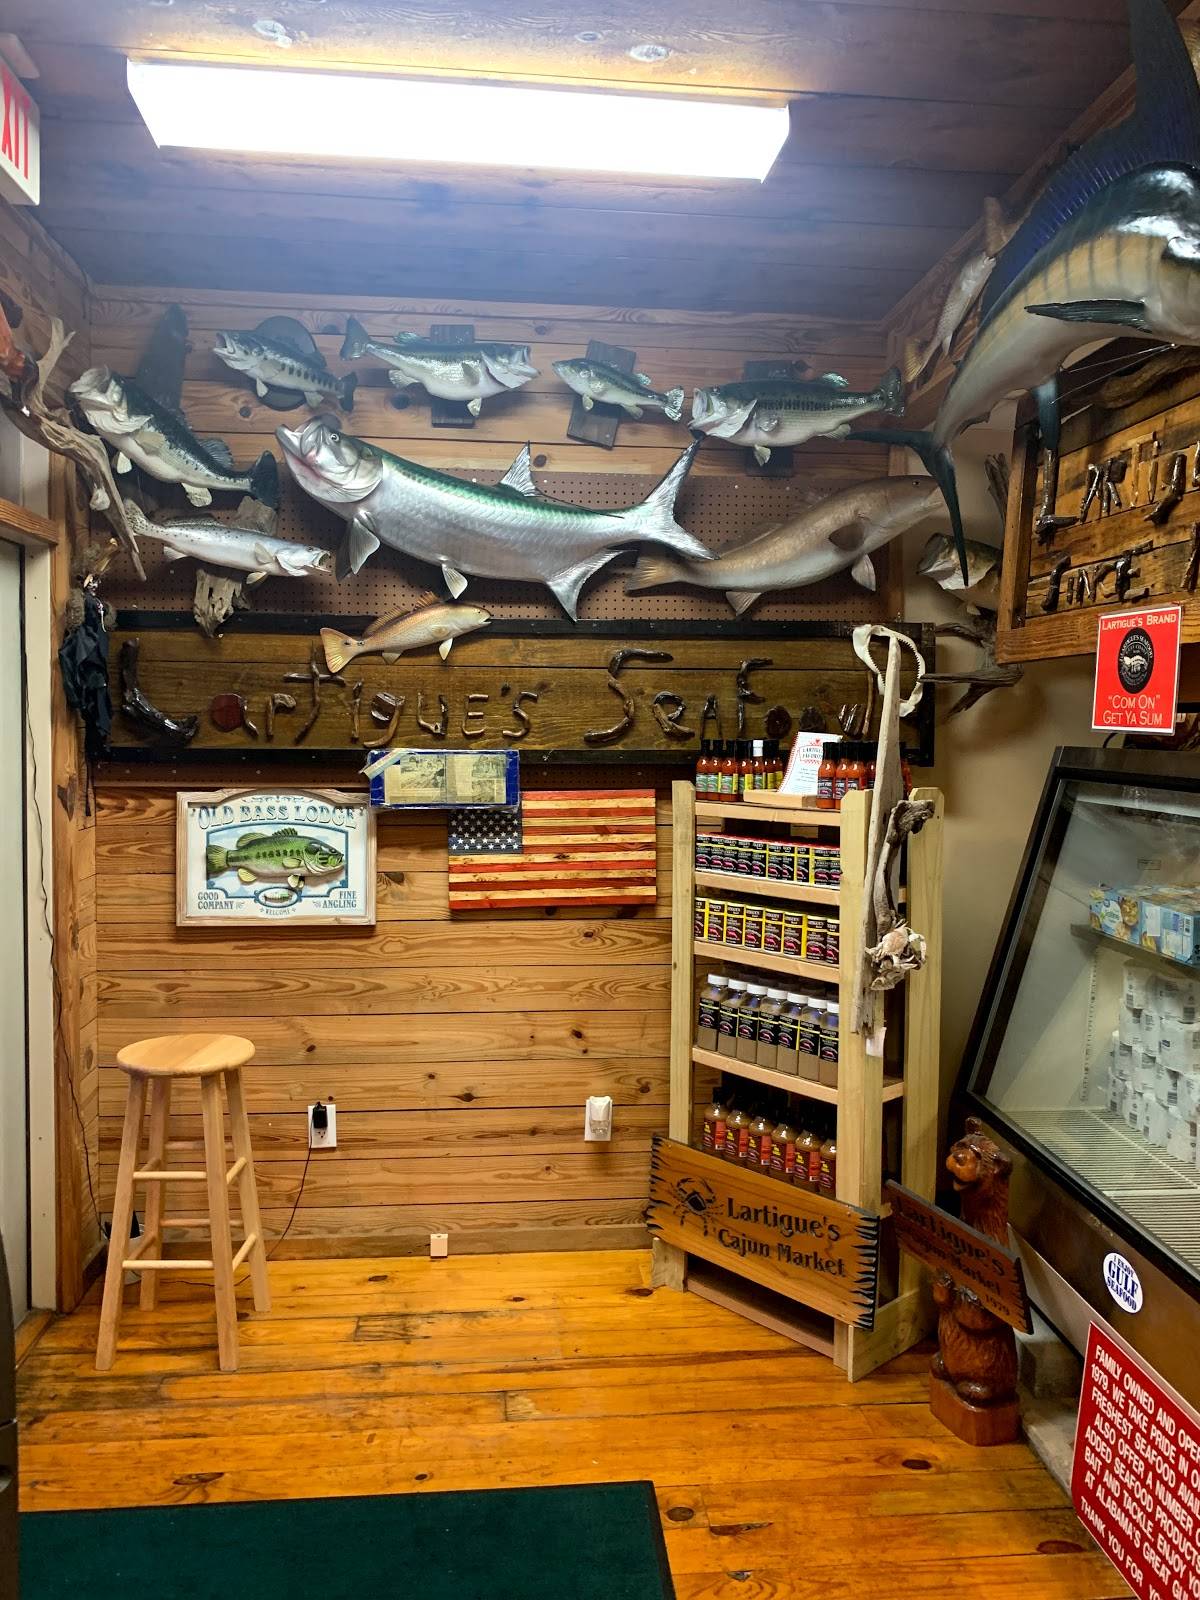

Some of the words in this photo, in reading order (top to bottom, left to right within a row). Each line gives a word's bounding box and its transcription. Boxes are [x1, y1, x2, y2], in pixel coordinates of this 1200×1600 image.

[1146, 613, 1177, 626] BRAND
[1103, 710, 1123, 724] GET
[1125, 710, 1137, 725] YA
[1139, 710, 1163, 726] SUM
[199, 805, 234, 830] OLD
[240, 805, 289, 822] BASS
[294, 805, 357, 829] LODGE
[198, 891, 219, 901] GOOD
[198, 901, 234, 910] COMPANY
[322, 900, 357, 909] ANGLING
[339, 890, 357, 900] FINE
[727, 1197, 841, 1241] Lartigue's
[718, 1228, 771, 1257] Cajun
[776, 1243, 847, 1278] Market
[1107, 1276, 1137, 1311] SEAFOOD
[1108, 1260, 1139, 1299] GULF
[1095, 1344, 1122, 1381] FAMILY
[1123, 1373, 1154, 1415] OWNED
[1156, 1407, 1176, 1437] AND
[1091, 1363, 1110, 1394] 1979.
[1112, 1383, 1125, 1409] WE
[1128, 1400, 1148, 1434] TAKE
[1150, 1424, 1176, 1464] PRIDE
[1178, 1454, 1189, 1478] IN
[1092, 1386, 1133, 1440] FRESHEST
[1134, 1432, 1176, 1488] SEAFOOD
[1085, 1425, 1112, 1464] ADDED
[1114, 1457, 1154, 1512] SEAFOOD
[1094, 1413, 1116, 1445] ALSO
[1118, 1438, 1145, 1479] OFFER
[1146, 1471, 1153, 1490] A
[1155, 1480, 1194, 1536] NUMBER
[1085, 1446, 1102, 1475] BAIT
[1103, 1469, 1120, 1498] AND
[1157, 1533, 1187, 1579] ENJOY
[1085, 1470, 1096, 1490] AT
[1096, 1484, 1141, 1548] ALABAMA'S
[1143, 1541, 1171, 1586] GREAT
[1081, 1495, 1106, 1538] THANK
[1108, 1530, 1124, 1561] YOU
[1126, 1555, 1143, 1587] FOR
